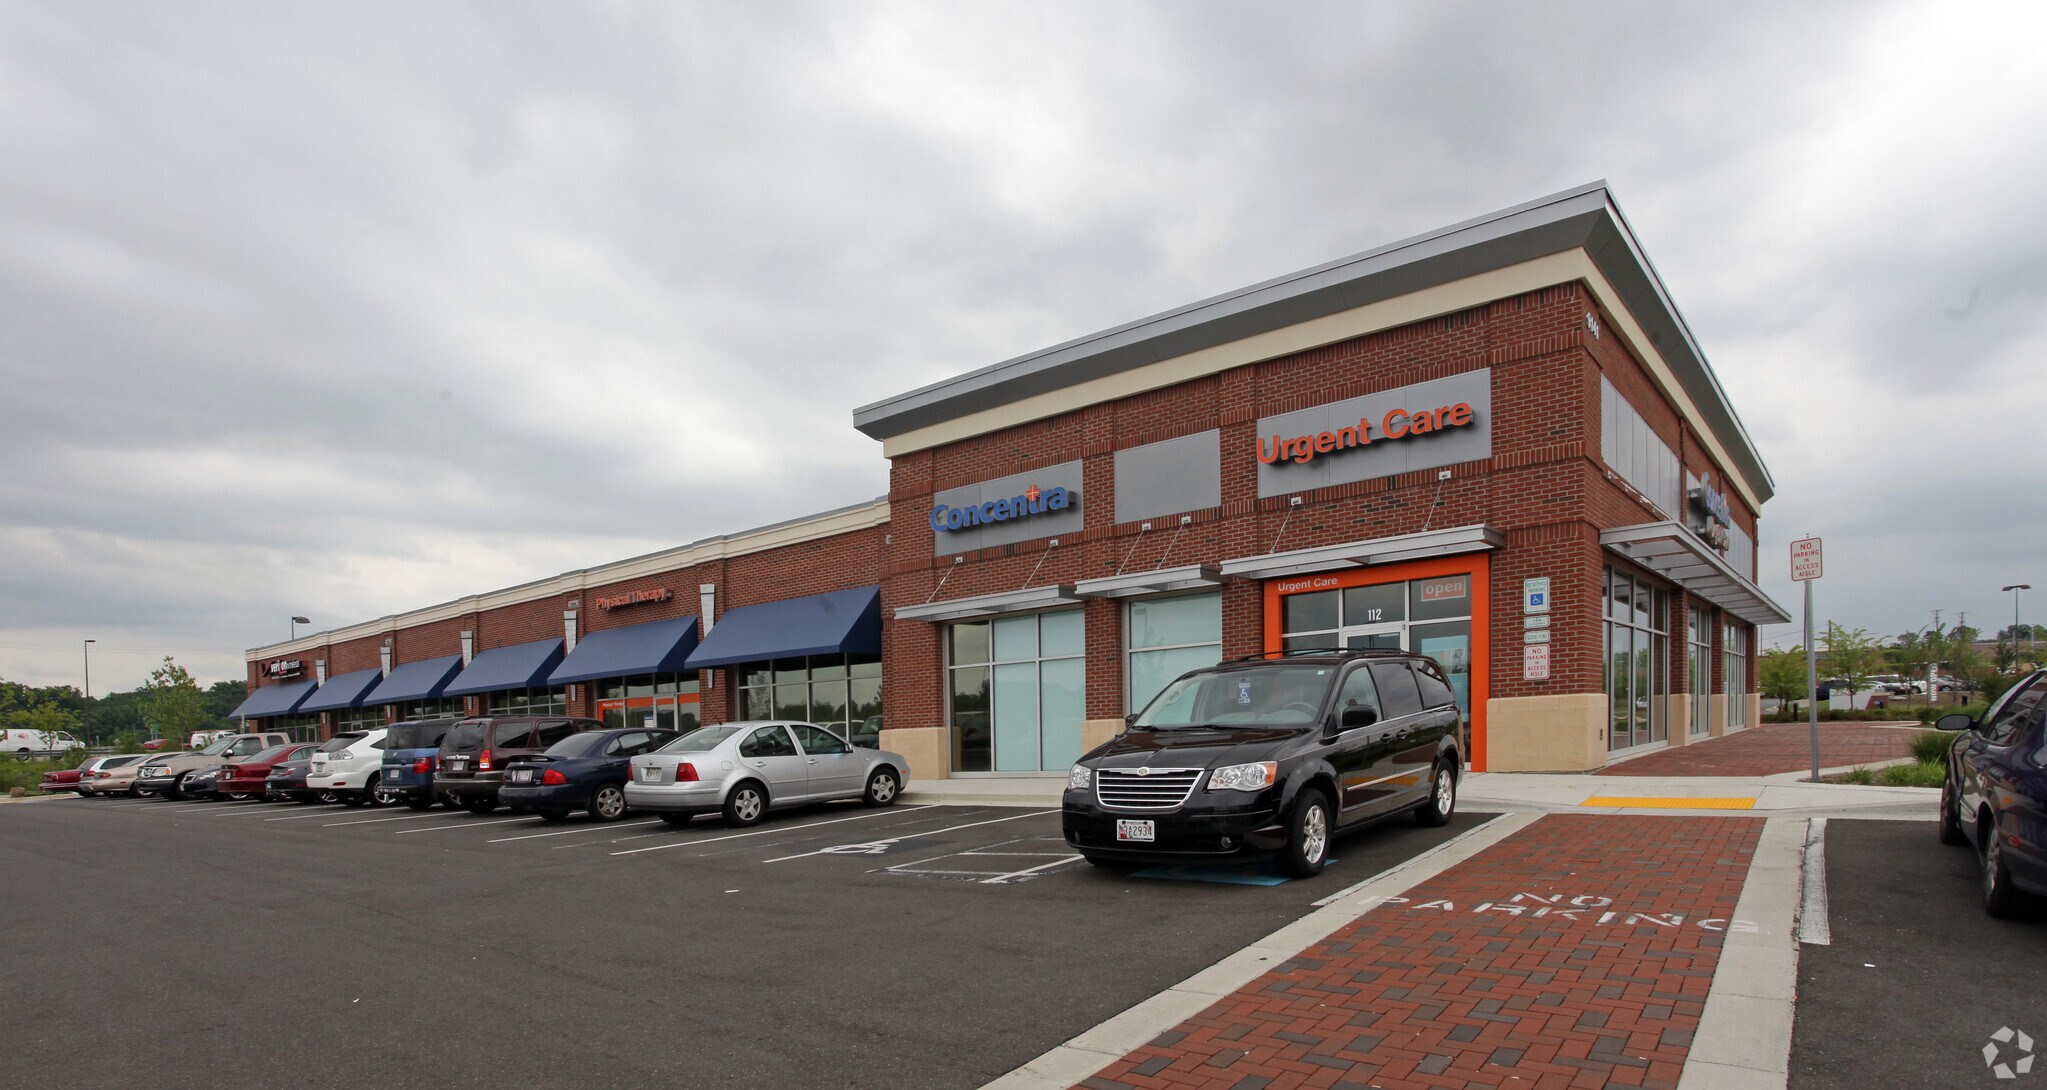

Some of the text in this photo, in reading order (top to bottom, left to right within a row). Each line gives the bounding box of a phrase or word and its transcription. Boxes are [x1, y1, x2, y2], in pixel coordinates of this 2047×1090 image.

[1256, 402, 1473, 464] Urgent Care
[929, 485, 1068, 533] Concentra
[1794, 550, 1819, 558] PARKING
[1800, 542, 1812, 550] NO
[1795, 562, 1819, 570] ACCESS
[1277, 577, 1338, 592] Urgent Care
[1425, 580, 1463, 597] open
[595, 587, 666, 610] Physical Therapy
[1367, 608, 1382, 621] 112
[1930, 683, 1938, 701] NOW
[1510, 892, 1612, 907] NO
[1355, 895, 1759, 933] PARKING
